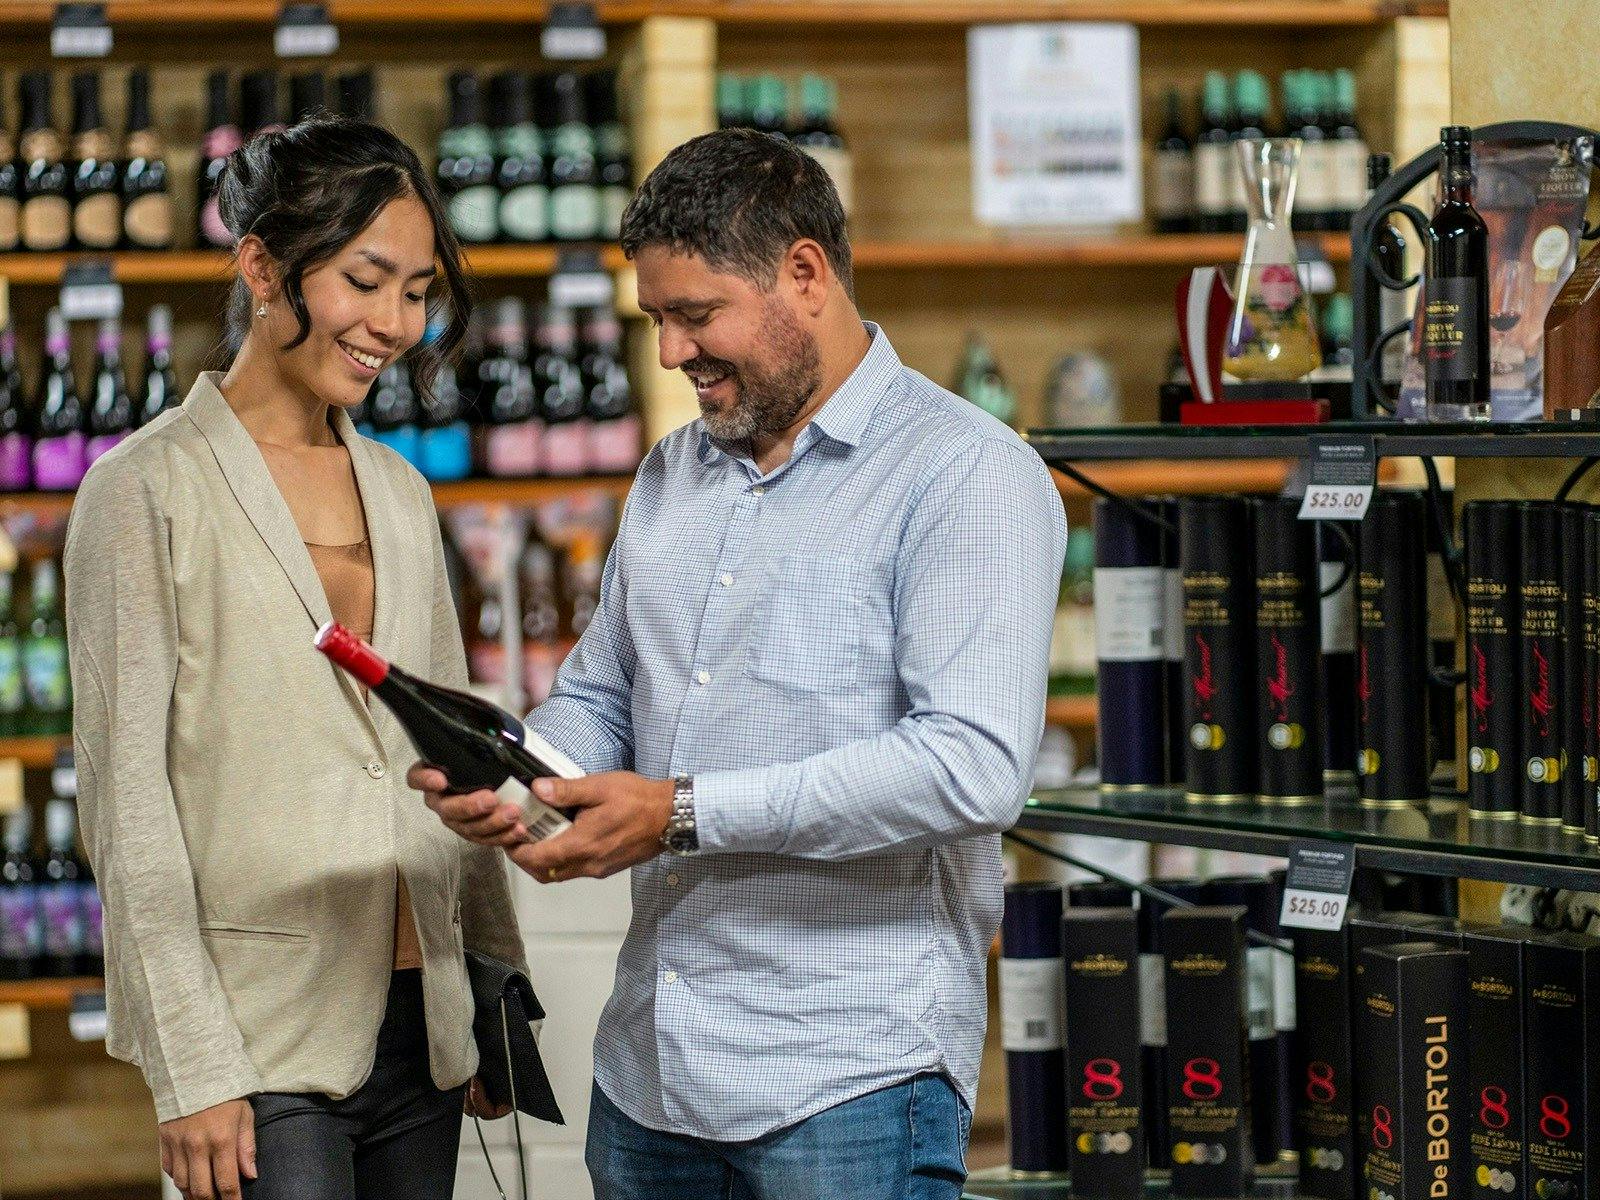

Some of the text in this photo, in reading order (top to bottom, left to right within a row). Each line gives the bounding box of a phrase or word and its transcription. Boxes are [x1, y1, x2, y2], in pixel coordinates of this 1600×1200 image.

[1310, 492, 1364, 508] $25.00
[1289, 896, 1340, 917] $25.00
[1082, 1057, 1125, 1101] 8
[1181, 1056, 1223, 1101] 8
[1305, 1060, 1337, 1103] 8
[1371, 1103, 1394, 1150] 8
[1480, 1085, 1511, 1130] 8
[1539, 1094, 1571, 1139] 8
